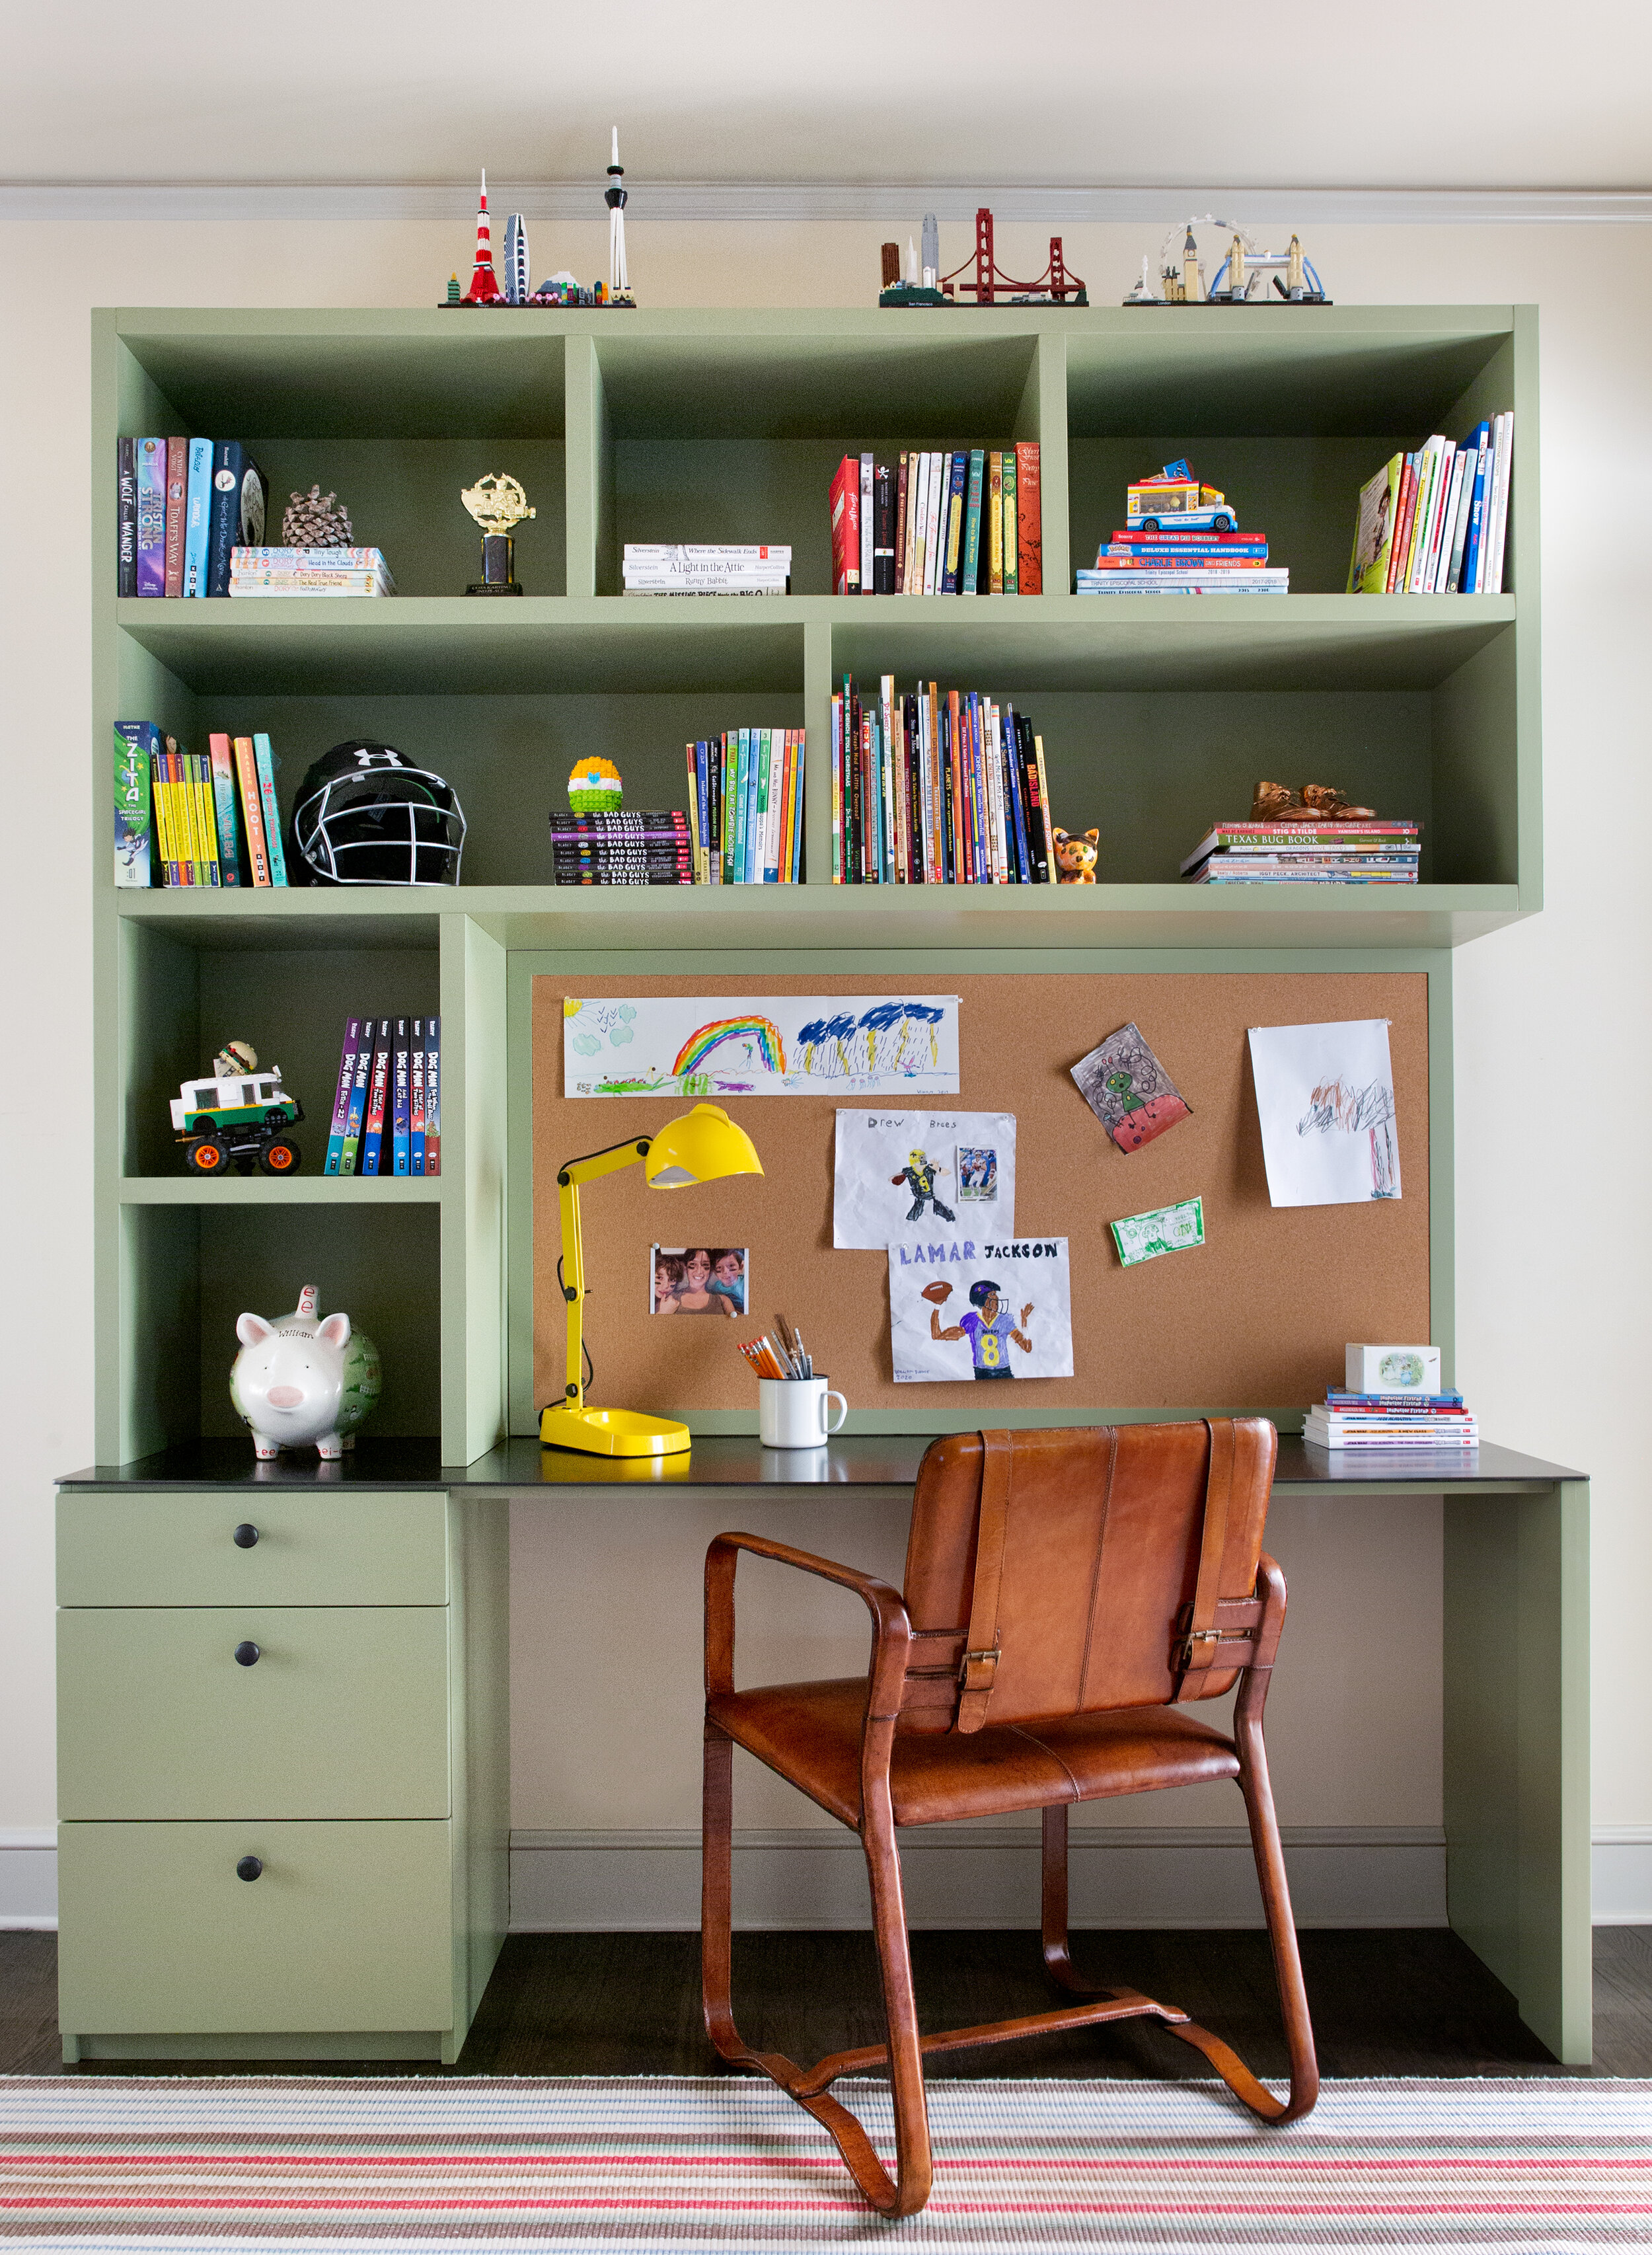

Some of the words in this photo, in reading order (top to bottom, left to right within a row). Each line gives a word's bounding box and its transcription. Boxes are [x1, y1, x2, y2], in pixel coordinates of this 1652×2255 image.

[121, 477, 133, 505] WOLF
[141, 487, 153, 550] STRONG
[153, 493, 163, 544] TRISTAN
[849, 511, 858, 531] Ulysses
[1473, 500, 1482, 525] Snow
[170, 507, 180, 541] TOAFF'S
[121, 522, 133, 562] WANDER
[169, 543, 179, 565] WAY
[1139, 558, 1172, 567] CHARLIE
[1175, 558, 1204, 567] BROWN
[669, 563, 677, 572] A
[678, 562, 698, 574] Light
[700, 563, 708, 572] in
[710, 562, 723, 572] the
[724, 562, 745, 572] Attic
[126, 743, 139, 802] ZITA
[1027, 764, 1038, 779] BAD
[1030, 780, 1040, 807] ISLAND
[248, 791, 260, 835] HOOT
[223, 814, 235, 859] SAMURAI
[1226, 835, 1258, 844] TEXAS
[1262, 835, 1285, 844] BUG
[1288, 835, 1320, 845] BOOK
[345, 1053, 356, 1070] DOG
[359, 1053, 370, 1069] DOG
[377, 1051, 388, 1069] DOG
[396, 1051, 408, 1068] DOG
[412, 1051, 424, 1069] DOG
[428, 1051, 439, 1069] DOG
[340, 1072, 352, 1089] MAN
[356, 1071, 366, 1089] MAN
[375, 1071, 385, 1088] MAN
[397, 1070, 407, 1087] MAN
[413, 1070, 424, 1087] MAN
[427, 1071, 438, 1087] MAN
[868, 1117, 904, 1128] Drew
[930, 1120, 957, 1129] Brees
[919, 1175, 930, 1193] 9
[899, 1240, 977, 1266] LAMAR
[984, 1242, 1059, 1259] JACKSON
[278, 1329, 314, 1339] William
[981, 1334, 1000, 1367] 8
